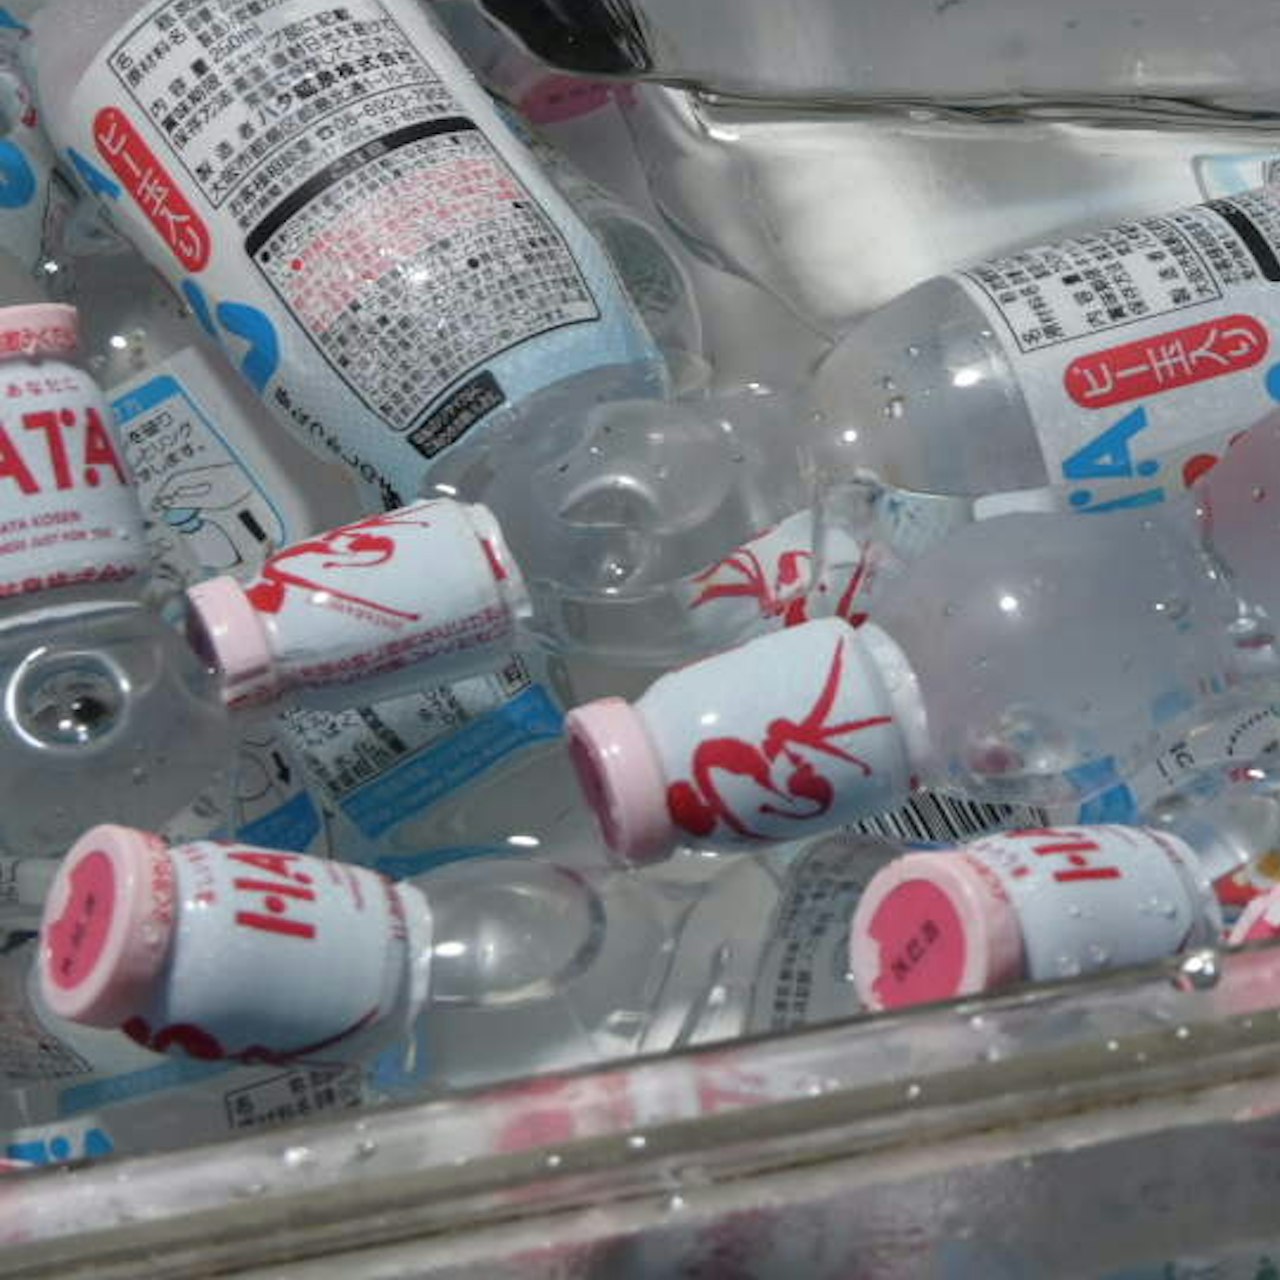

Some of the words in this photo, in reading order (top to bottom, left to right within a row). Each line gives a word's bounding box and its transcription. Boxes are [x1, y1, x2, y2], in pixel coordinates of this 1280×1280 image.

[97, 116, 214, 271] ビー玉入り
[1072, 322, 1261, 402] ビー玉入り
[0, 407, 128, 497] ATA
